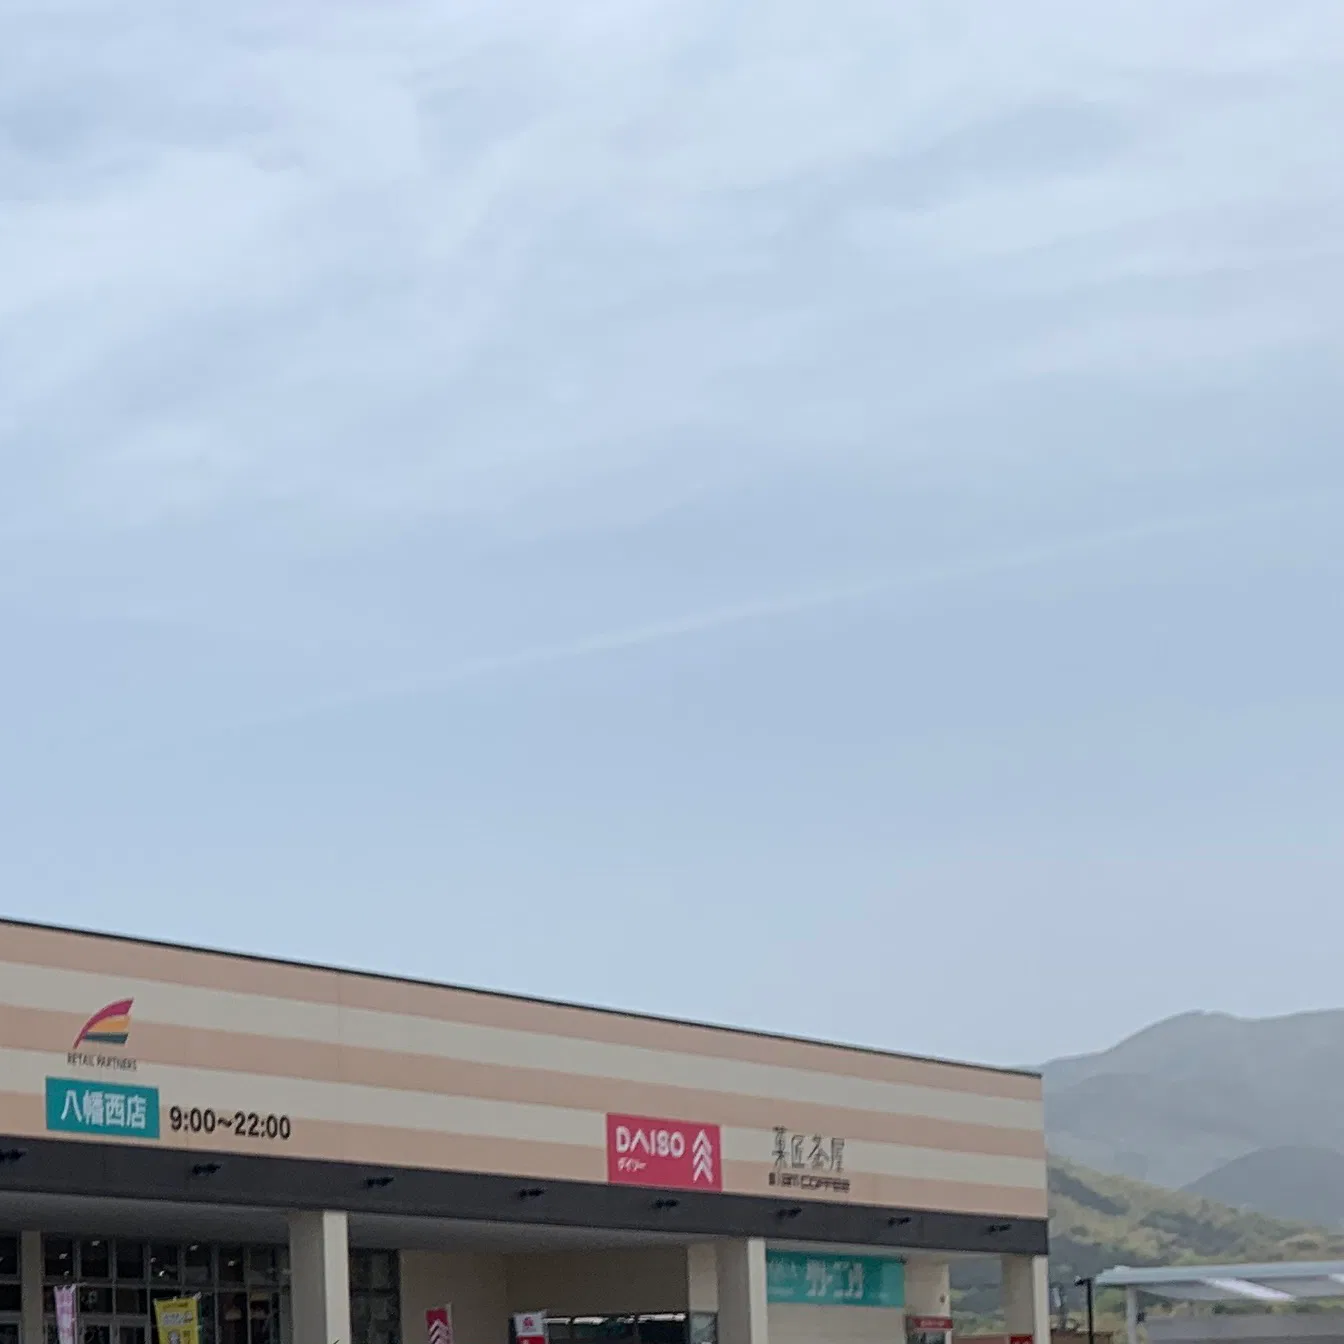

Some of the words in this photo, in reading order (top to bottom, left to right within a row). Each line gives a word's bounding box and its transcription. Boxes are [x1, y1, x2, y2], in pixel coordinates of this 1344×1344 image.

[66, 1051, 95, 1067] RETAIL
[96, 1054, 138, 1071] PARTNERS
[60, 1089, 147, 1130] 八幡西店
[615, 1125, 686, 1159] DAISO
